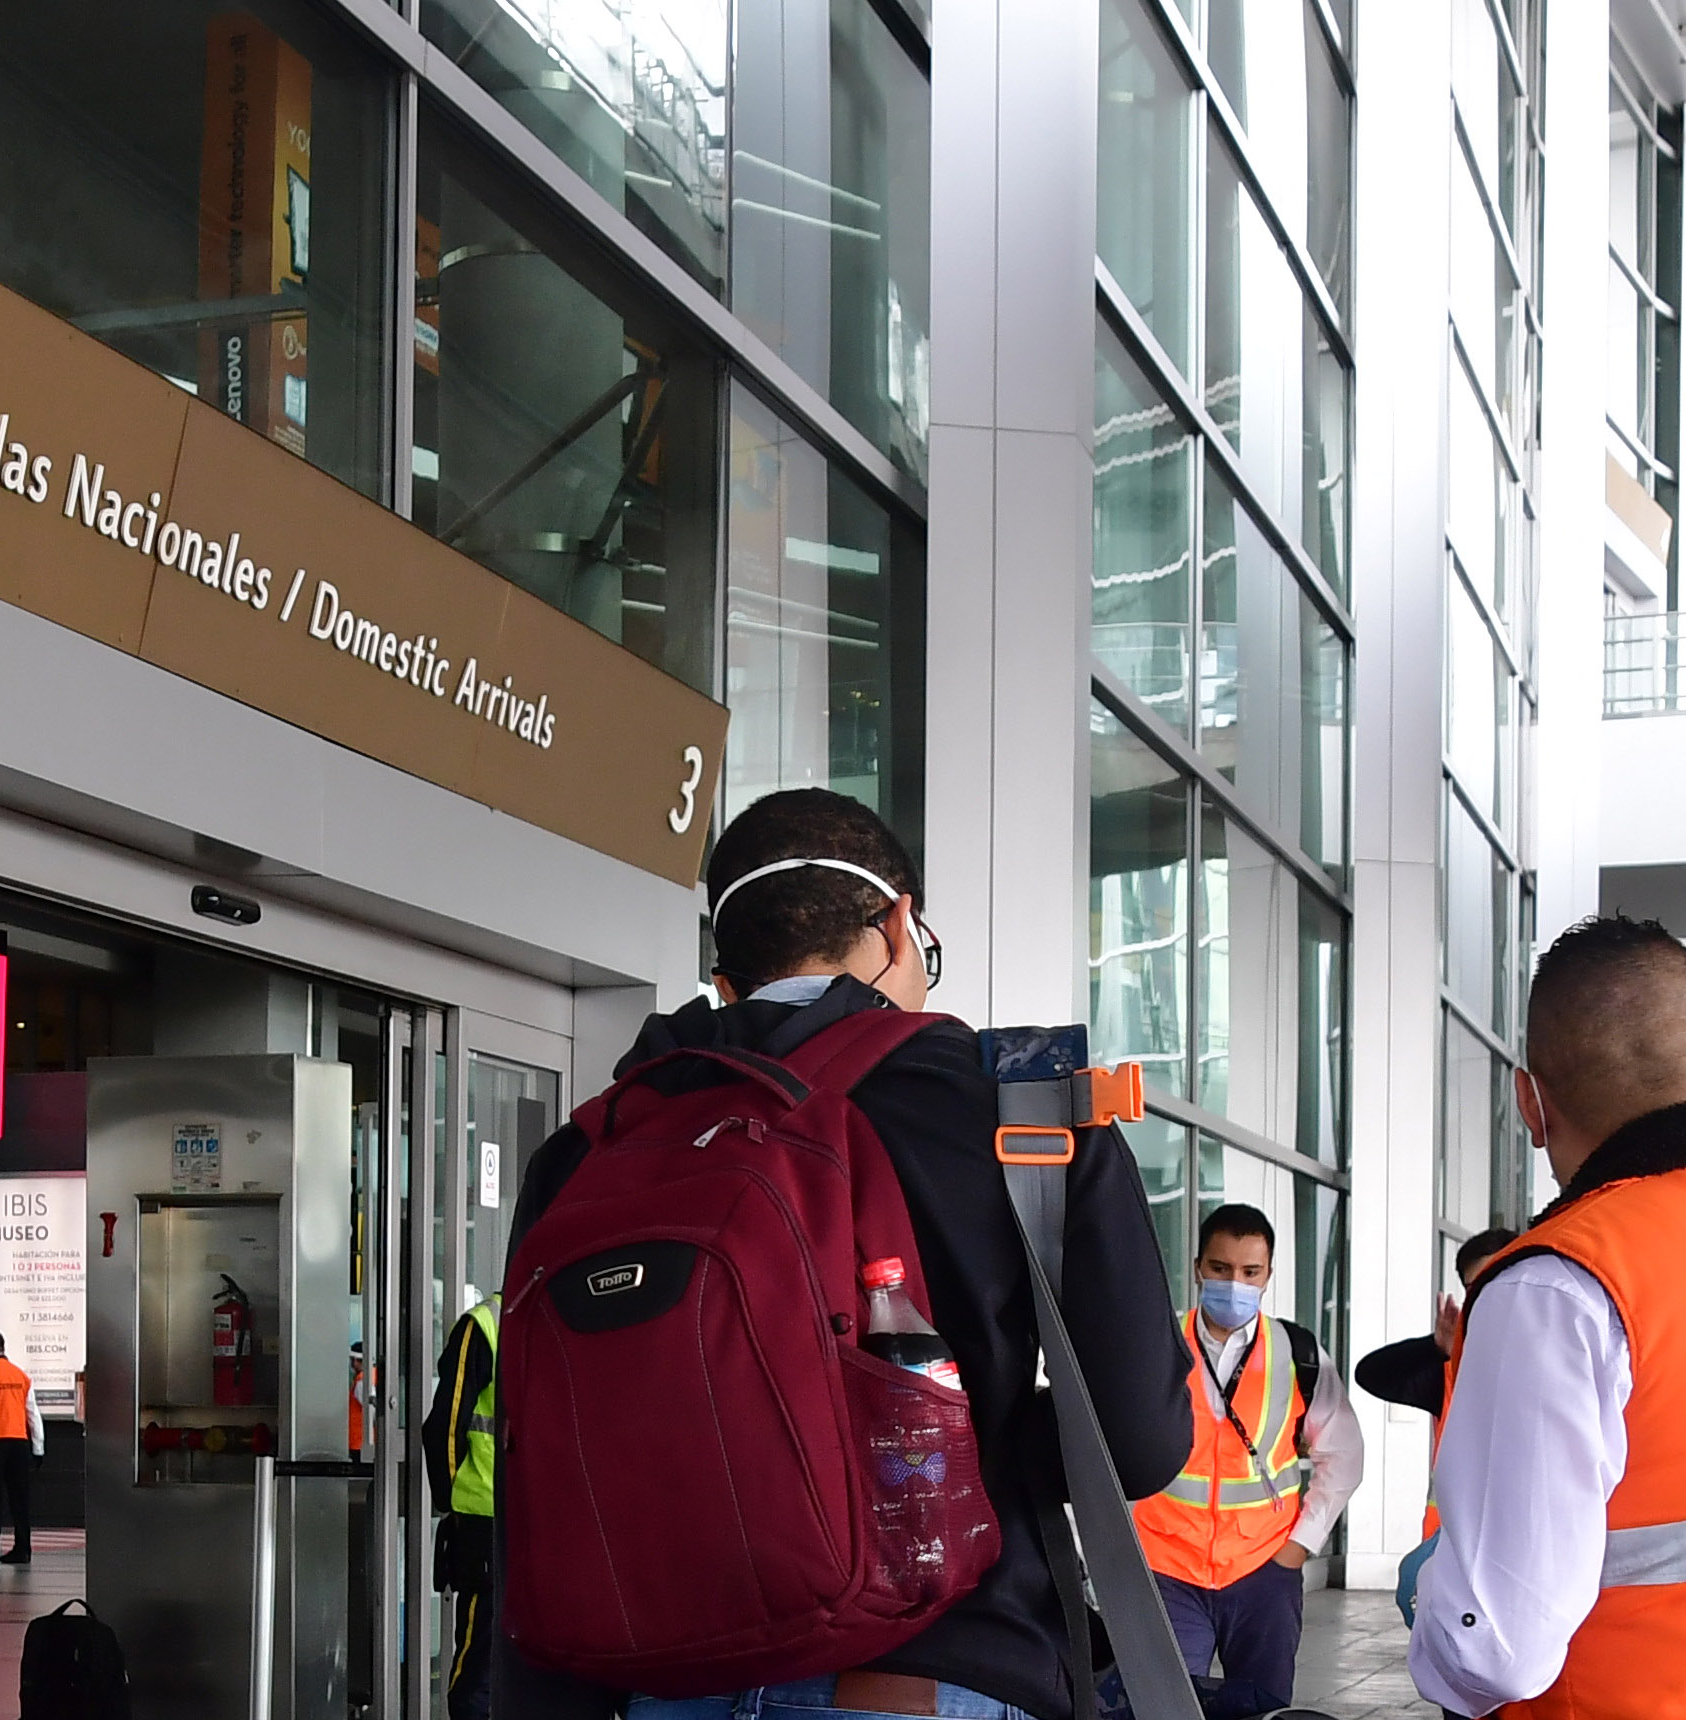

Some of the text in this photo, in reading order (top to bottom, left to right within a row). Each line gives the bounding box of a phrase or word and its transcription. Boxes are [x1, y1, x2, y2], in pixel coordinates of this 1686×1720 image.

[64, 453, 273, 611] Nacionales
[279, 569, 306, 623] /
[309, 579, 451, 698] Domestic
[454, 657, 556, 750] Arrivals
[668, 745, 704, 835] 3
[4, 1193, 49, 1218] IBIS
[12, 1249, 81, 1259] HABITACIÓN PARA
[34, 1262, 82, 1271] PERSONAS
[596, 1271, 633, 1290] TOTTO
[19, 1313, 30, 1322] 57
[25, 1344, 67, 1354] IBIS.COM
